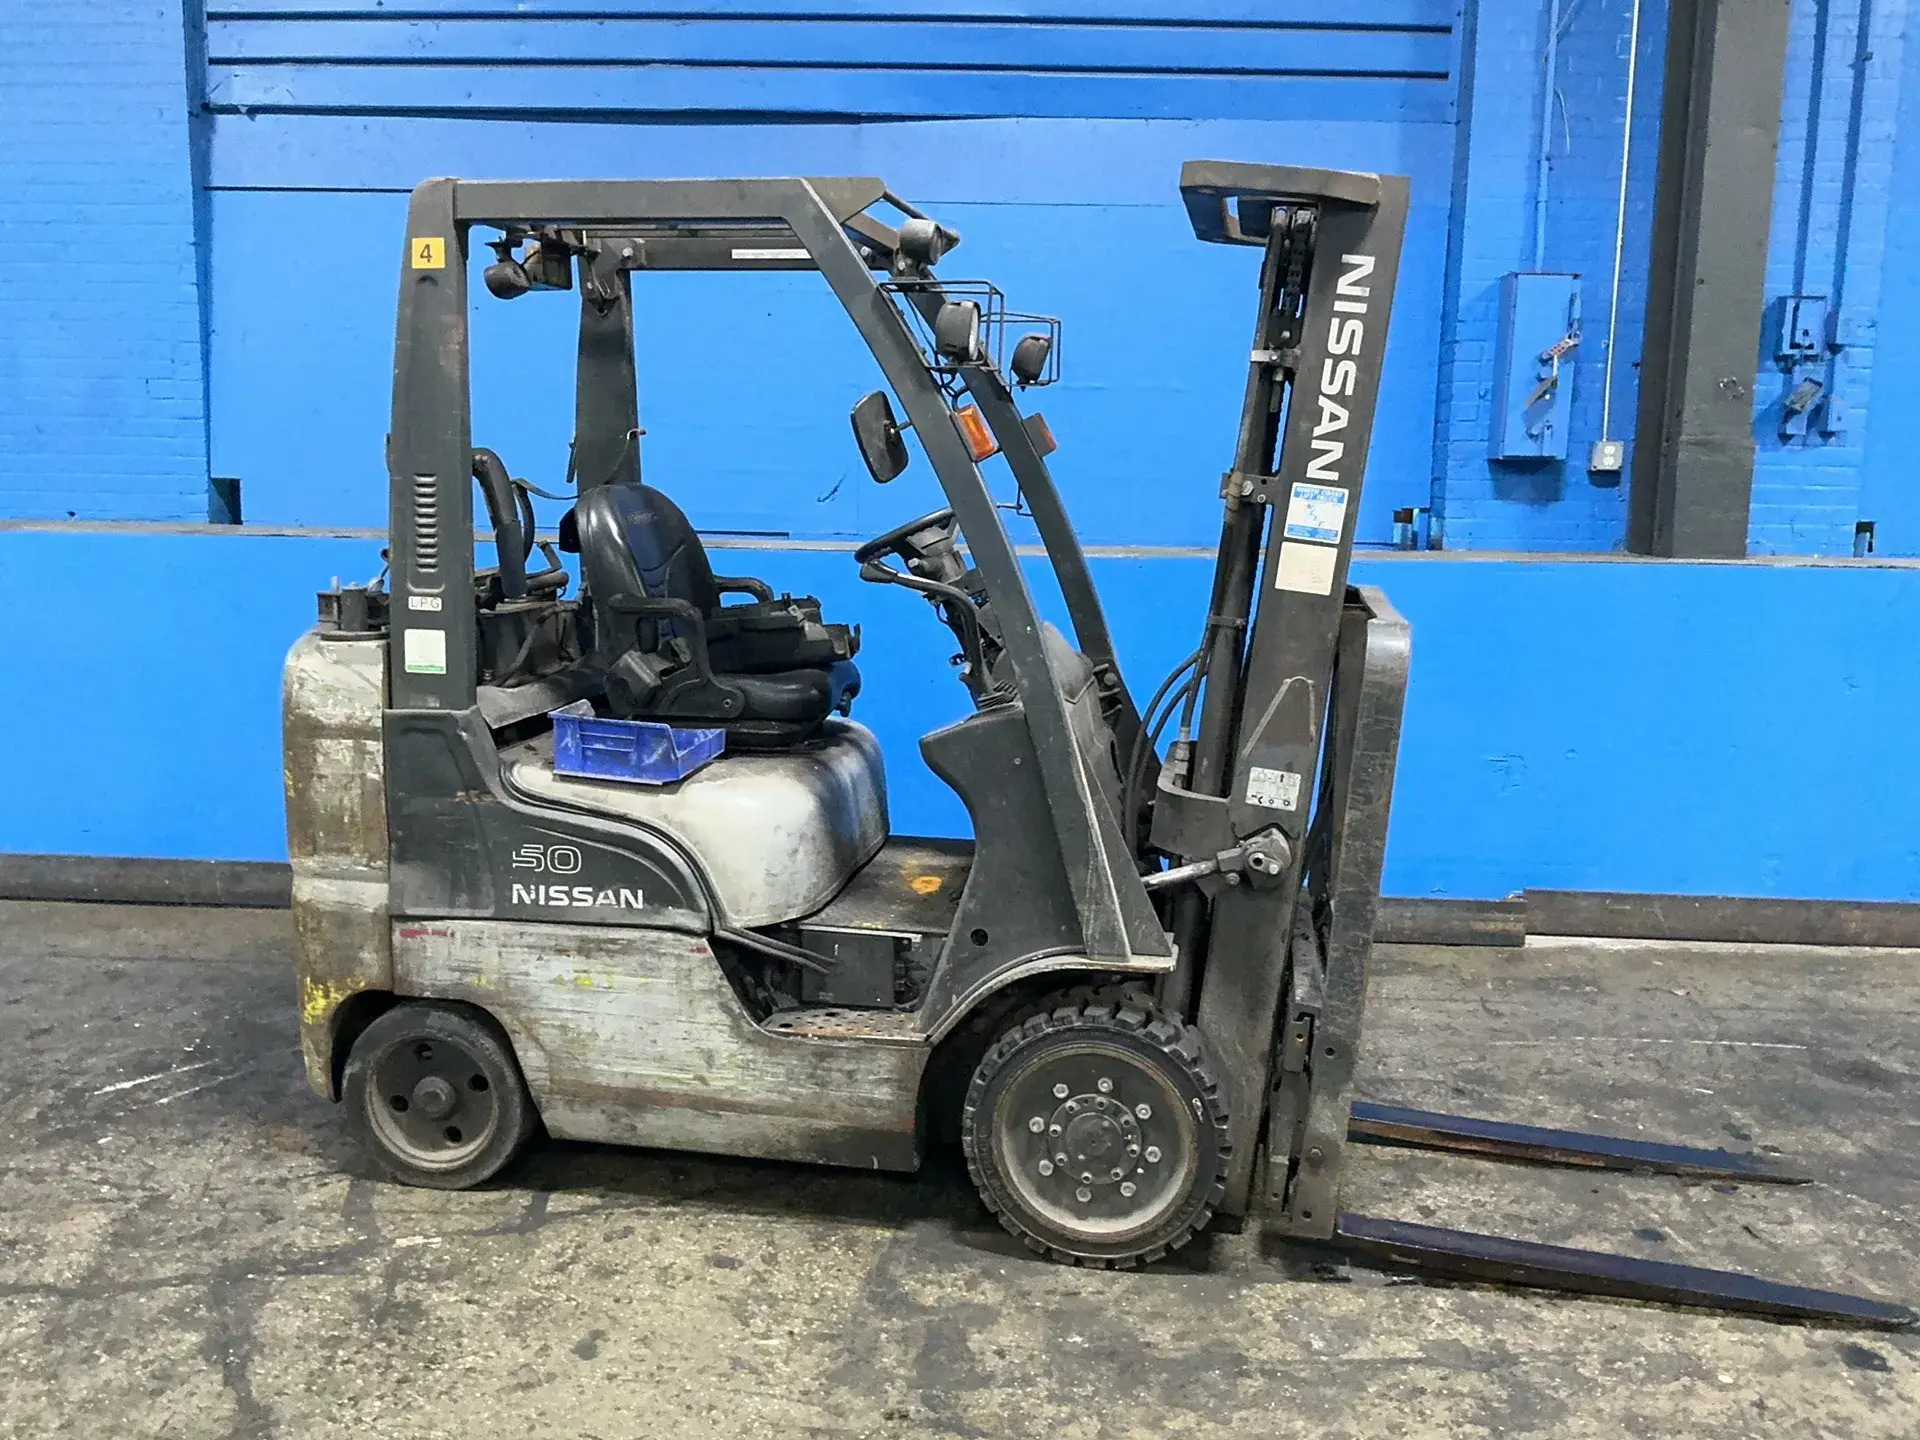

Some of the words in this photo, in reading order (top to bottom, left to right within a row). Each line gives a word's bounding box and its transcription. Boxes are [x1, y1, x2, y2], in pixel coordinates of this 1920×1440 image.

[419, 243, 433, 263] 4
[1305, 253, 1376, 481] NISSAN
[511, 843, 582, 874] 50
[511, 883, 644, 910] NISSAN
